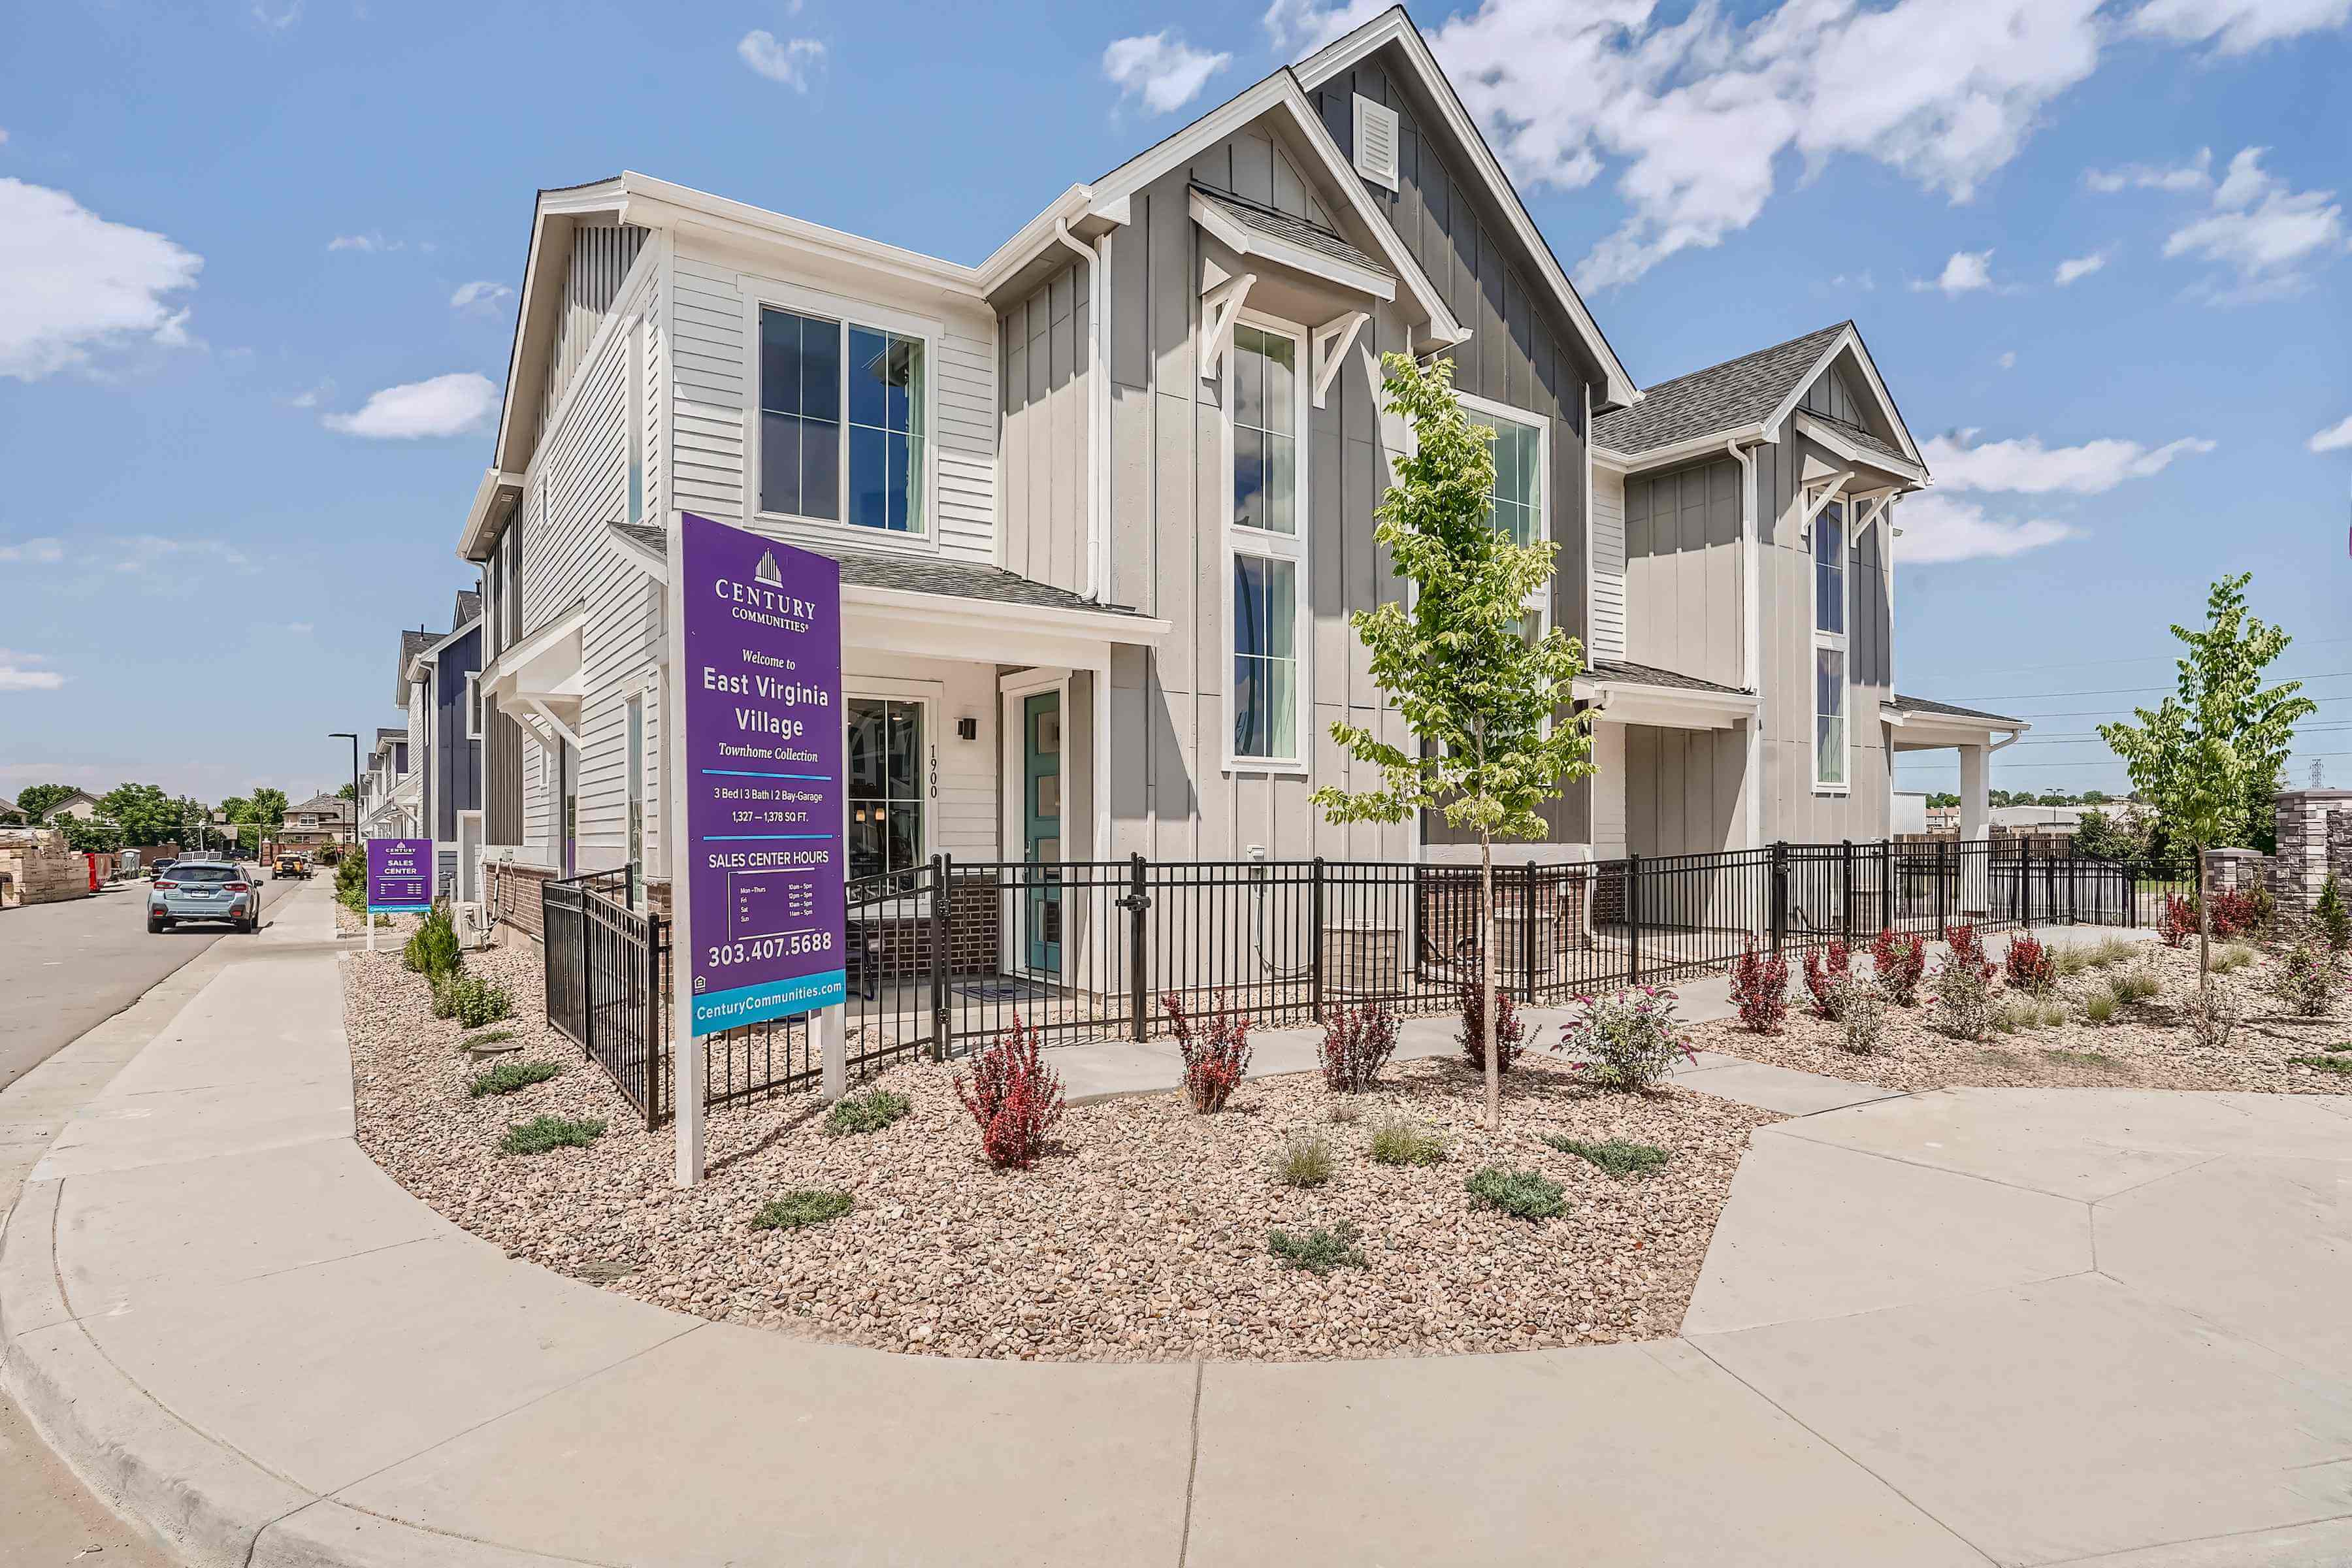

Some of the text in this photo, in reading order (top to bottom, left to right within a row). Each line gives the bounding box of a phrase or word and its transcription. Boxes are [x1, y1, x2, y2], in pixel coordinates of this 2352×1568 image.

[715, 578, 816, 620] CENTURY
[742, 649, 796, 670] Welcome to
[703, 666, 828, 706] East Virginia
[735, 708, 804, 740] Village
[719, 742, 818, 763] Townhome Collection
[714, 787, 720, 798] 3
[722, 788, 738, 799] Bed
[744, 789, 750, 799] 3
[751, 789, 770, 800] Bath
[775, 790, 780, 800] 2
[732, 811, 753, 823] 1,327
[763, 811, 783, 823] 1,378
[784, 811, 796, 823] SQ
[797, 811, 809, 823] FT.
[709, 850, 829, 868] SALES CENTER HOURS
[709, 932, 832, 968] 303.407.5688
[696, 981, 841, 1020] CenturyCommunities.com
